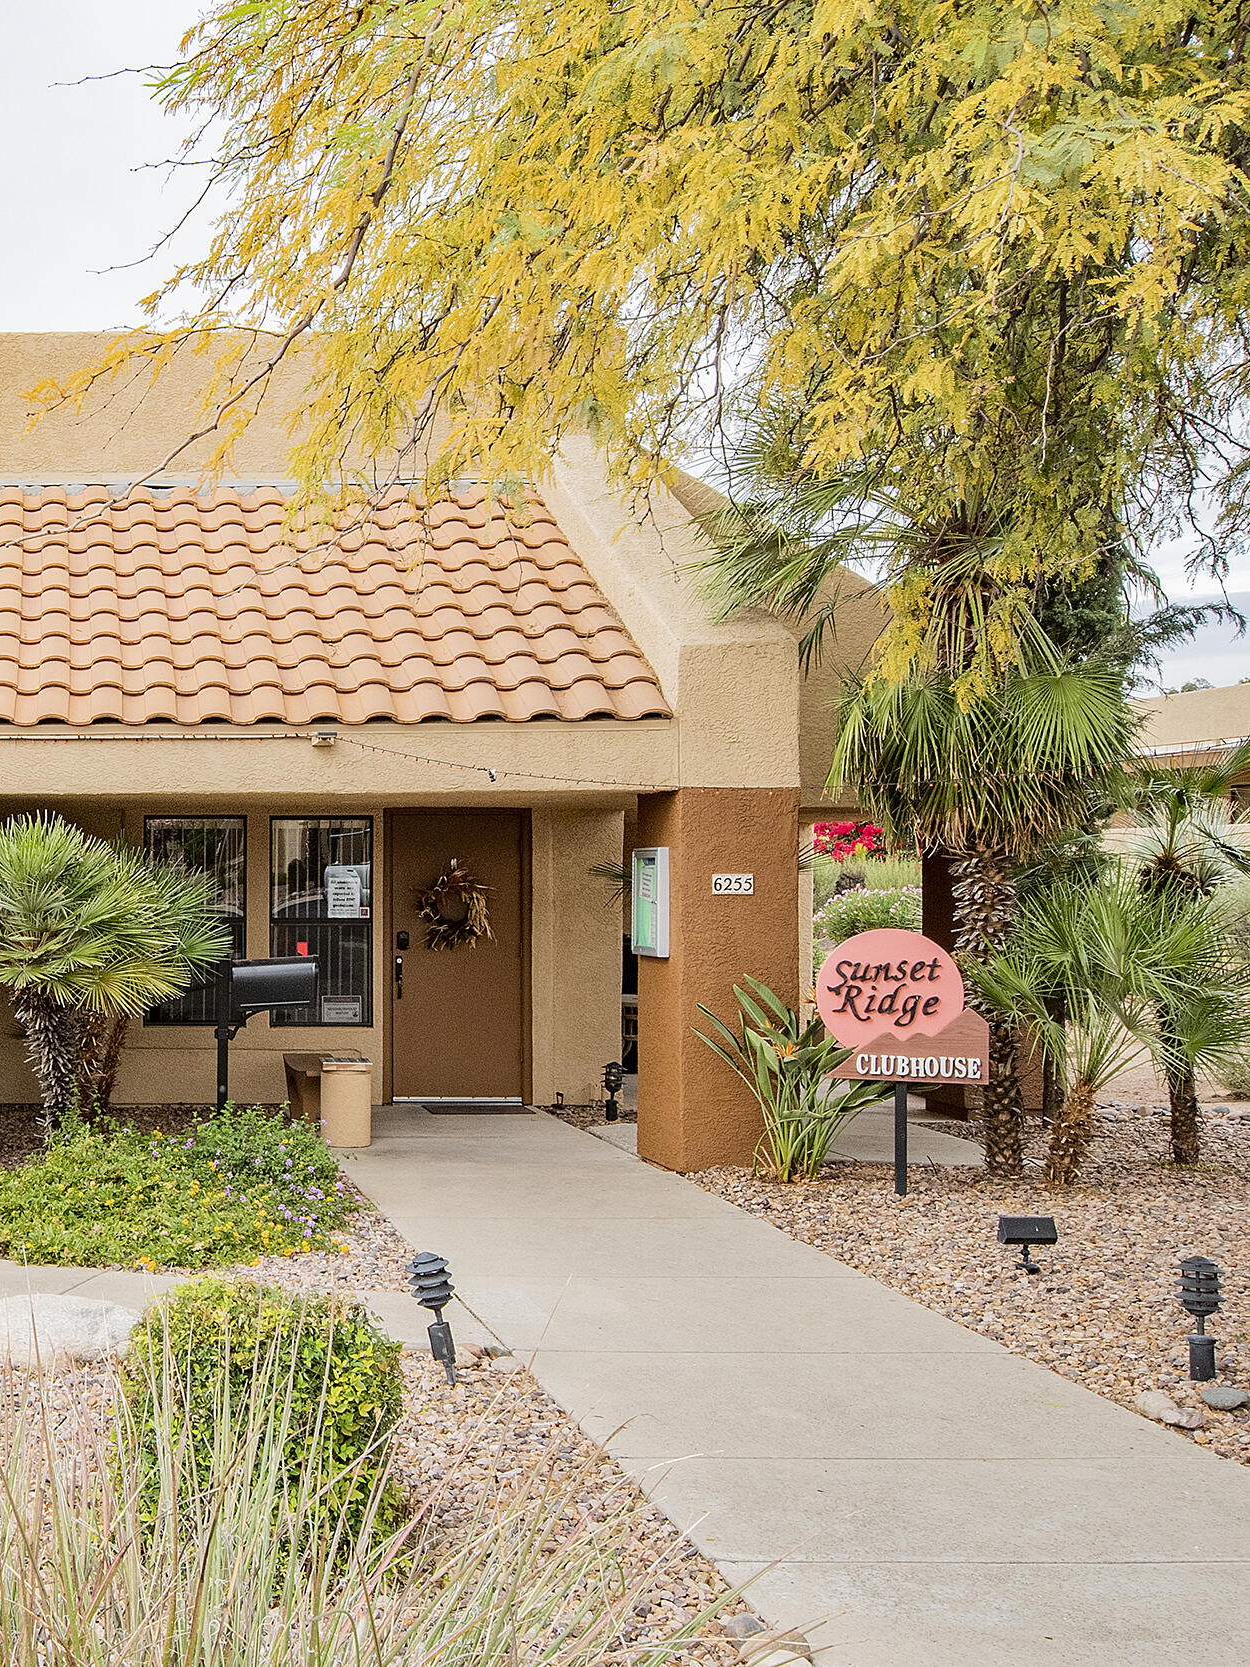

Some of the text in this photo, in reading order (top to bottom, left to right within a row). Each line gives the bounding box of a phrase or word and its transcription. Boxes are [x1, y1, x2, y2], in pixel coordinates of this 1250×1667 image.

[714, 877, 753, 891] 6255
[827, 957, 942, 996] Sunset
[832, 983, 940, 1027] Ridge
[856, 1053, 982, 1079] CLUBHOUSE
